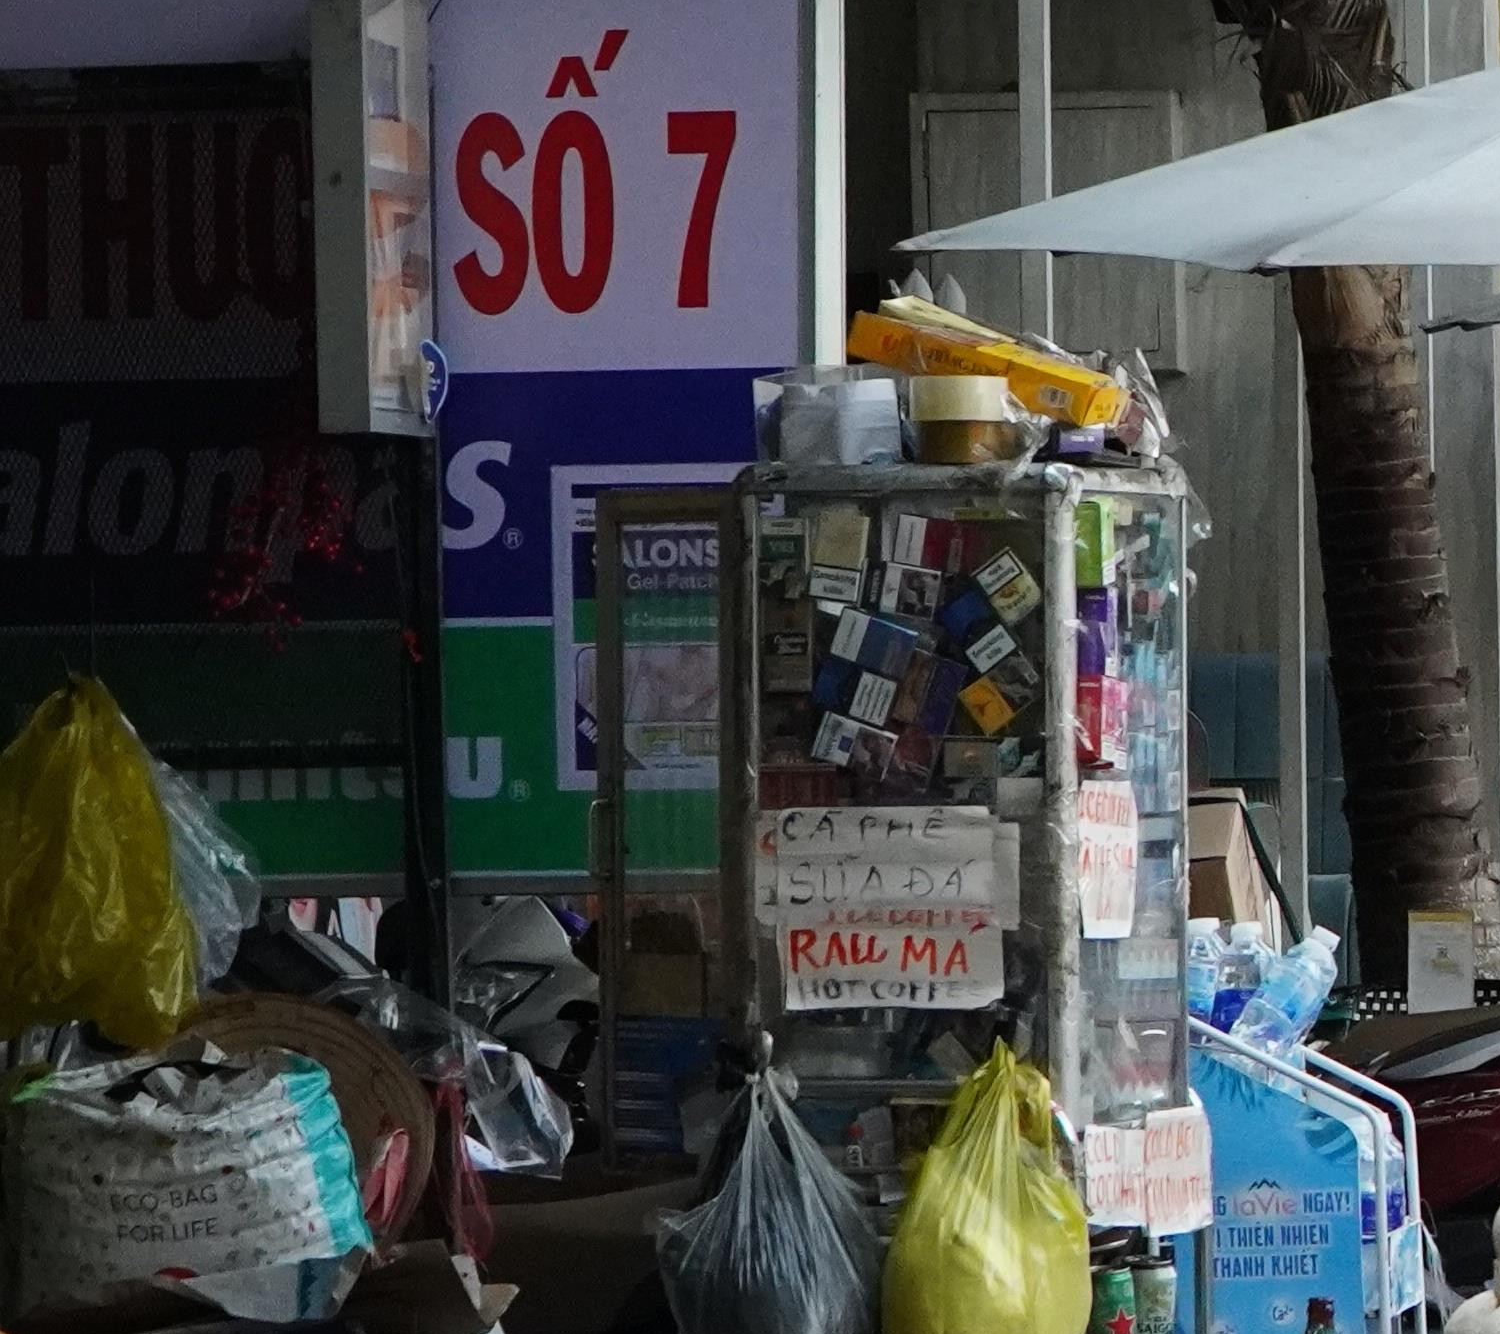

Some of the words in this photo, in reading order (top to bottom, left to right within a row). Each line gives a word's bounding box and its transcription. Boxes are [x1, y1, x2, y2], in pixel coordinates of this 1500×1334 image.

[453, 29, 629, 315] SỐ
[666, 110, 738, 309] 7
[800, 978, 861, 1001] HOT
[109, 1184, 218, 1214] ECO-BAG
[1303, 1191, 1351, 1215] NGAY!
[115, 1223, 165, 1243] FOR
[171, 1217, 218, 1242] LIFE
[1229, 1222, 1275, 1248] THIÊN
[1281, 1221, 1330, 1246] NHIÊN
[1272, 1248, 1319, 1277] KHIẾT
